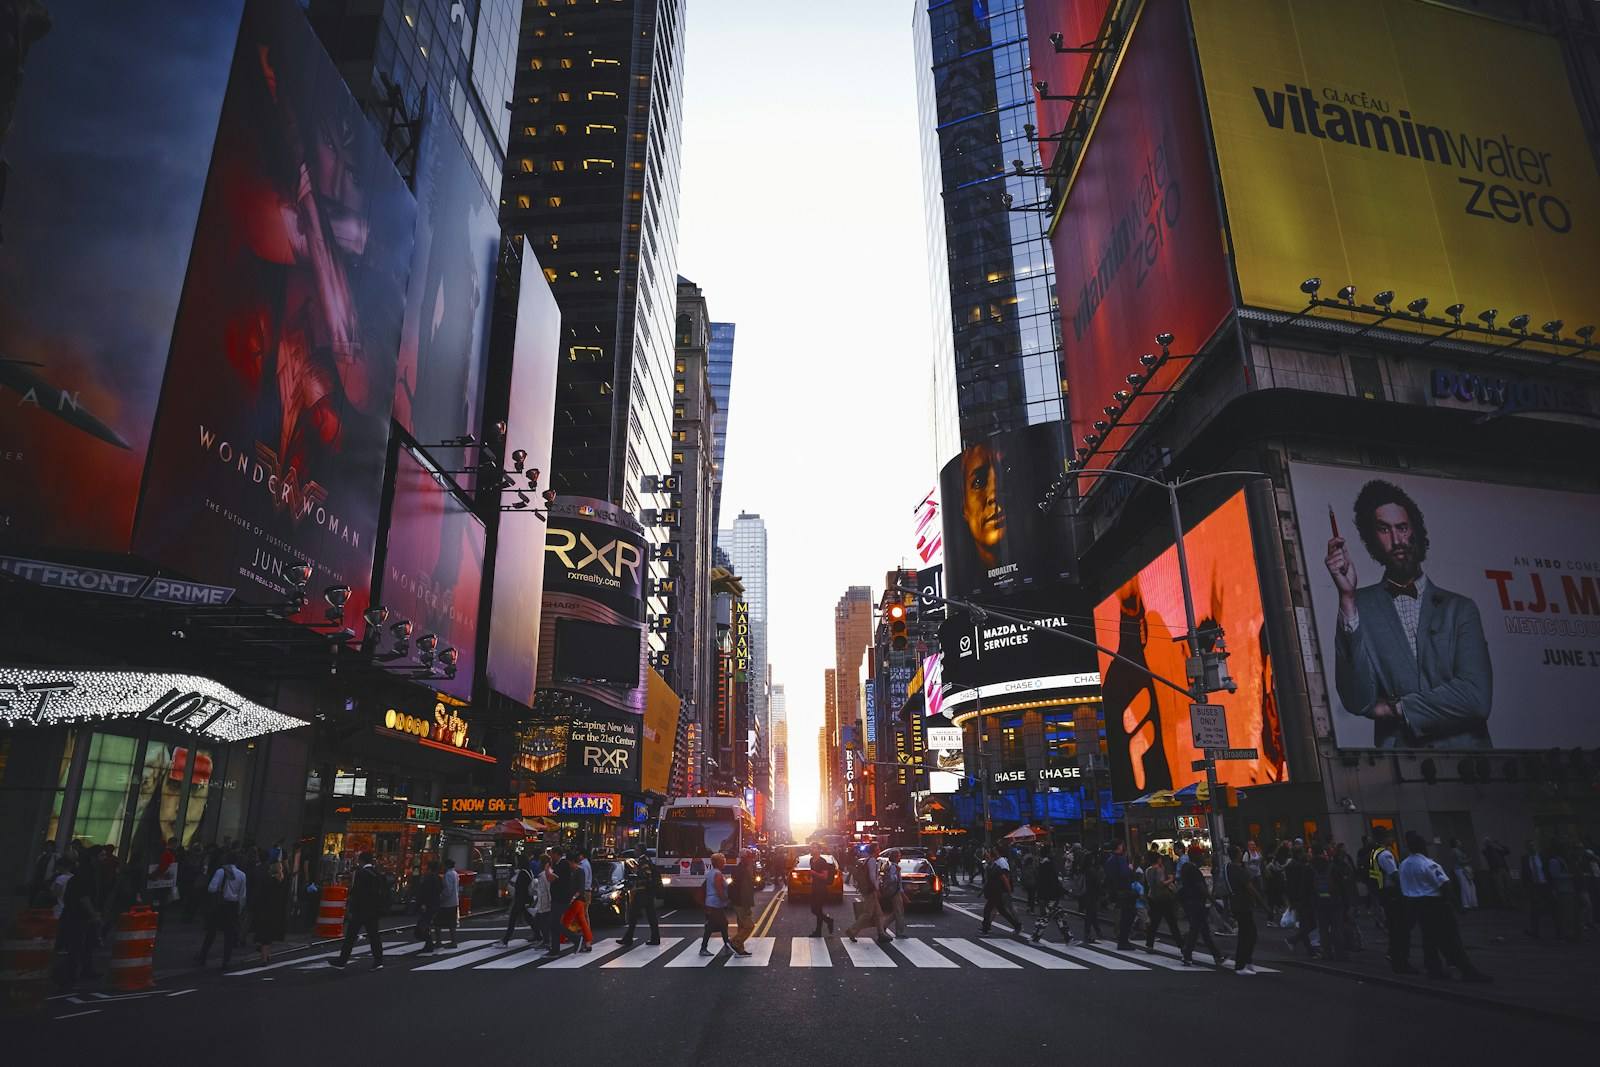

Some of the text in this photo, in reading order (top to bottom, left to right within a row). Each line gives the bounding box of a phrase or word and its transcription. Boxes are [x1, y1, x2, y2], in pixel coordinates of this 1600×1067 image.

[1252, 83, 1552, 187] vitaminwater
[1459, 177, 1572, 234] zero
[200, 424, 360, 548] WONDER WOMAN
[205, 500, 220, 513] THE
[223, 510, 251, 530] FUTURE
[254, 526, 263, 536] OF
[266, 535, 293, 553] JUSTICE
[252, 547, 289, 577] JUN
[545, 527, 640, 586] RXR
[1514, 557, 1529, 567] AN
[1534, 558, 1561, 569] HBO
[567, 571, 621, 588] rxrrealty.com
[661, 477, 676, 666] CHAMPS
[154, 581, 225, 605] PRIME
[391, 565, 438, 608] WONDER
[737, 602, 748, 670] MADAME
[984, 624, 1017, 639] MAZDA
[984, 634, 1029, 651] SERVICES
[1544, 649, 1585, 666] JUNE
[1005, 682, 1033, 692] CHASE
[572, 719, 606, 733] Shaping
[607, 721, 623, 732] New
[572, 731, 585, 741] for
[586, 732, 600, 742] the
[584, 746, 629, 768] RXR
[593, 767, 622, 775] REALTY
[846, 750, 854, 802] REGAL
[452, 798, 485, 812] KNOW
[549, 796, 614, 813] CHAMPS
